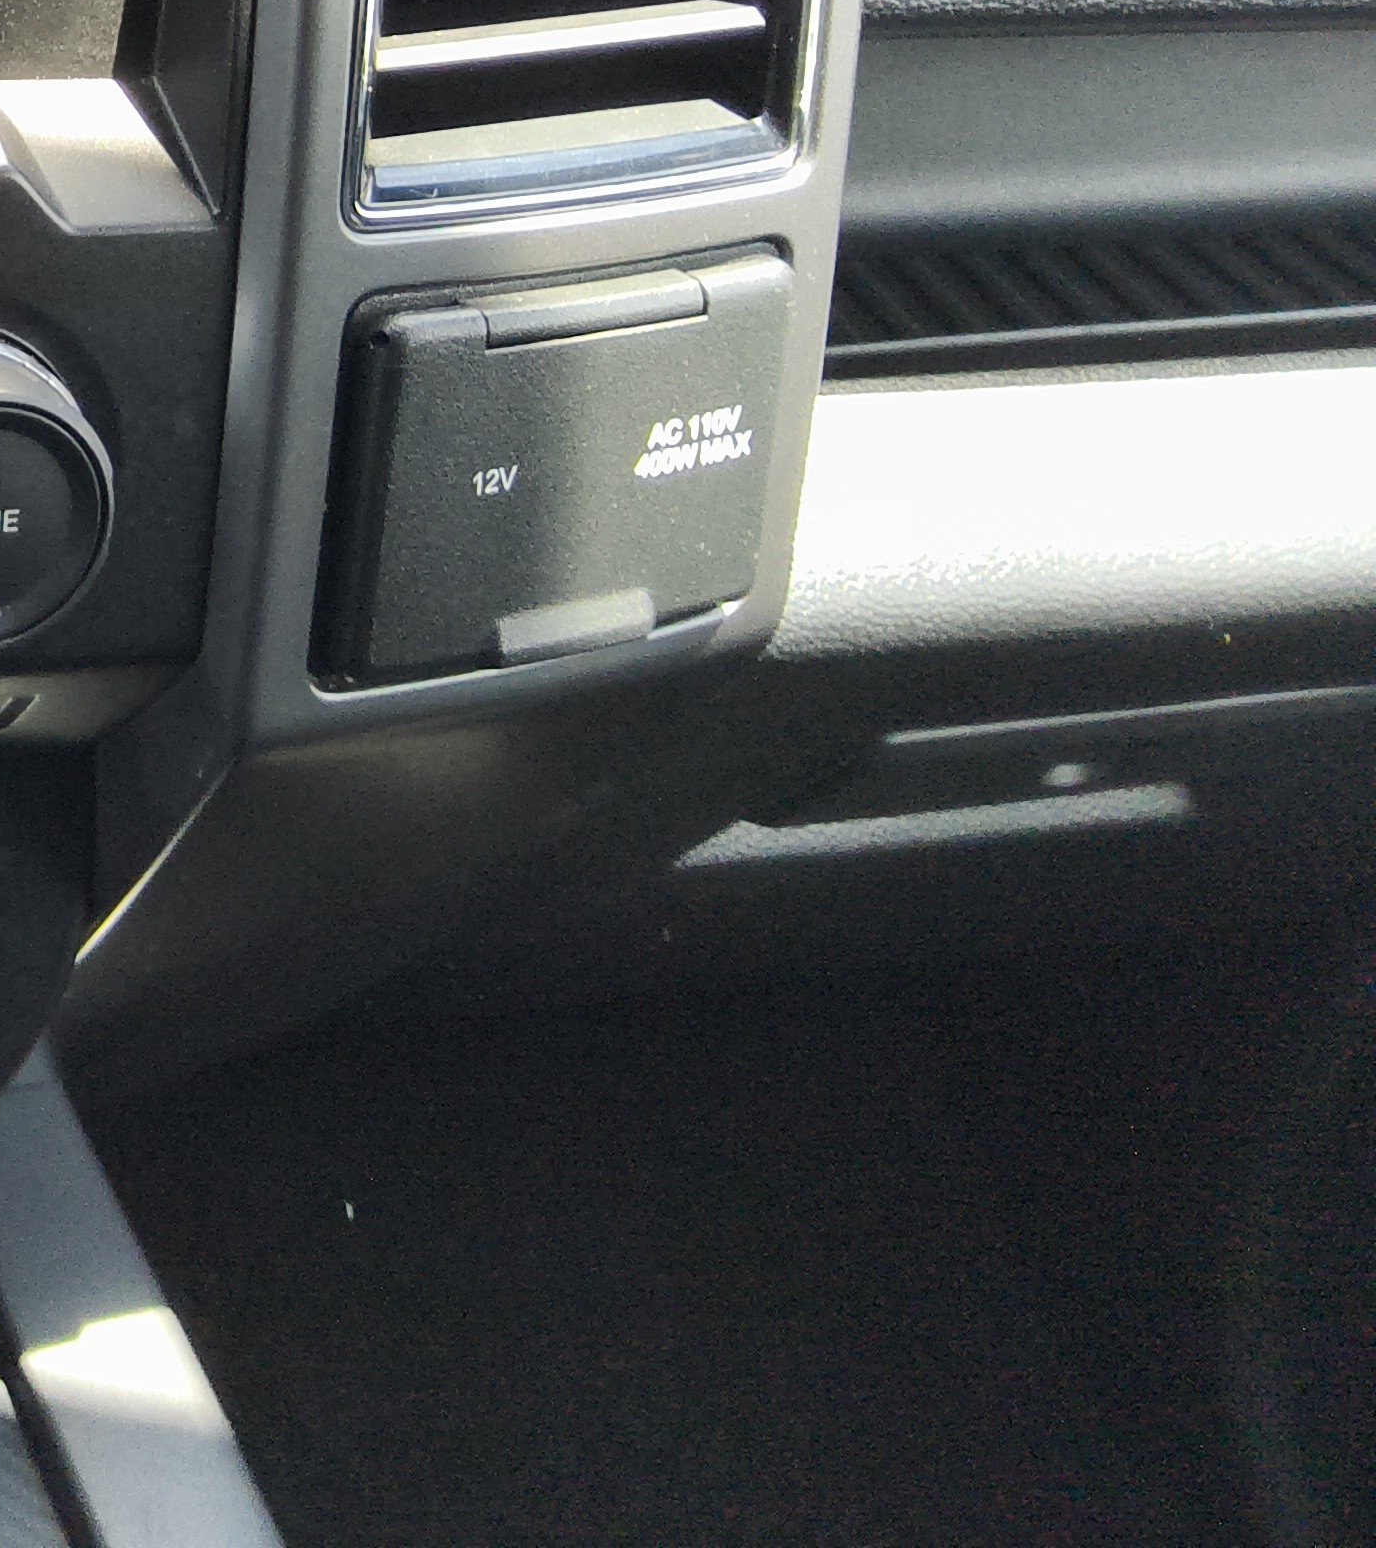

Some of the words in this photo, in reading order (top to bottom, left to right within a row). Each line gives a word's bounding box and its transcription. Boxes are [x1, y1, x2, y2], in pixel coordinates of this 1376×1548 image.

[648, 417, 684, 450] AC
[699, 429, 753, 466] MAX
[472, 464, 518, 497] 12V
